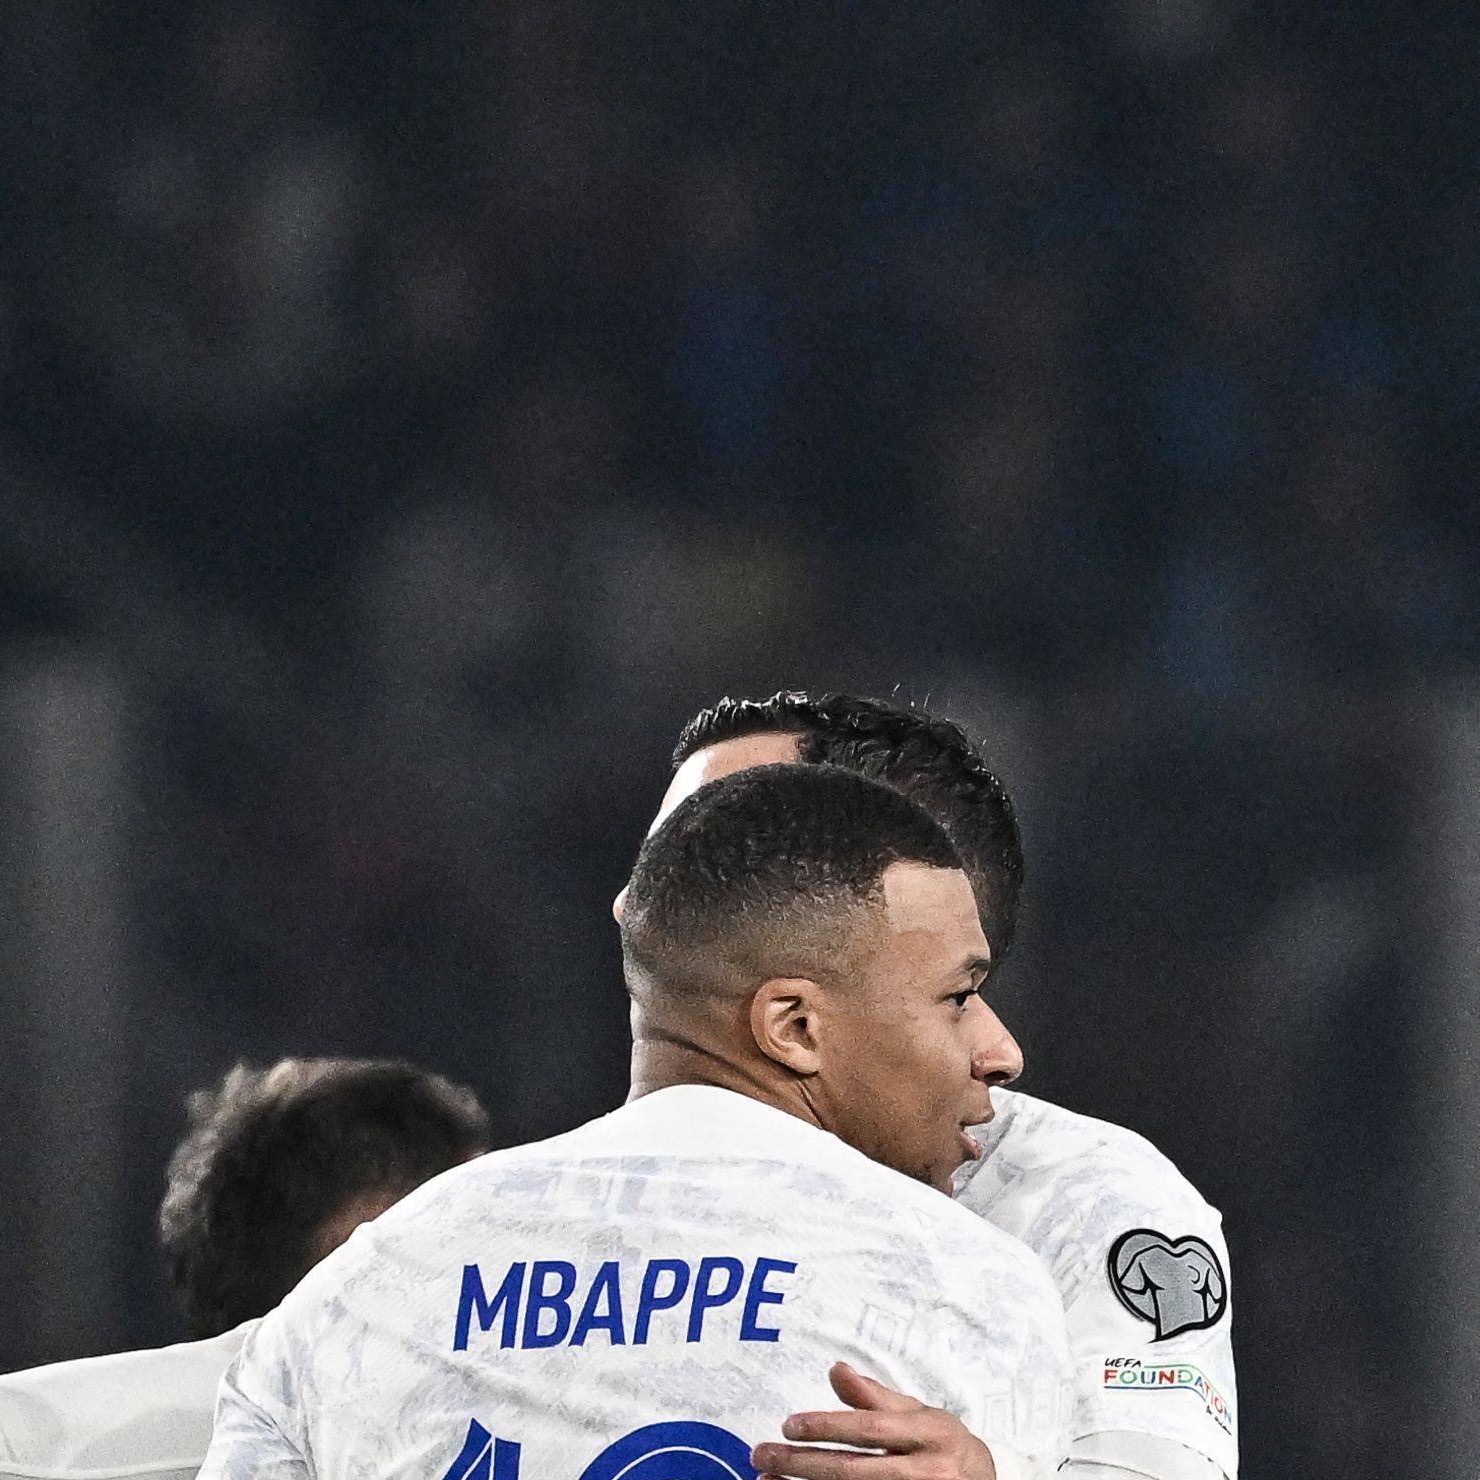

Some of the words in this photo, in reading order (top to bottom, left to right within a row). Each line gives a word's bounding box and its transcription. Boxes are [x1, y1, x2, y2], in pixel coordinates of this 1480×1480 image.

[452, 1256, 798, 1351] MBAPPE
[1104, 1356, 1142, 1369] UEFA
[1103, 1368, 1233, 1425] FOUNDATION
